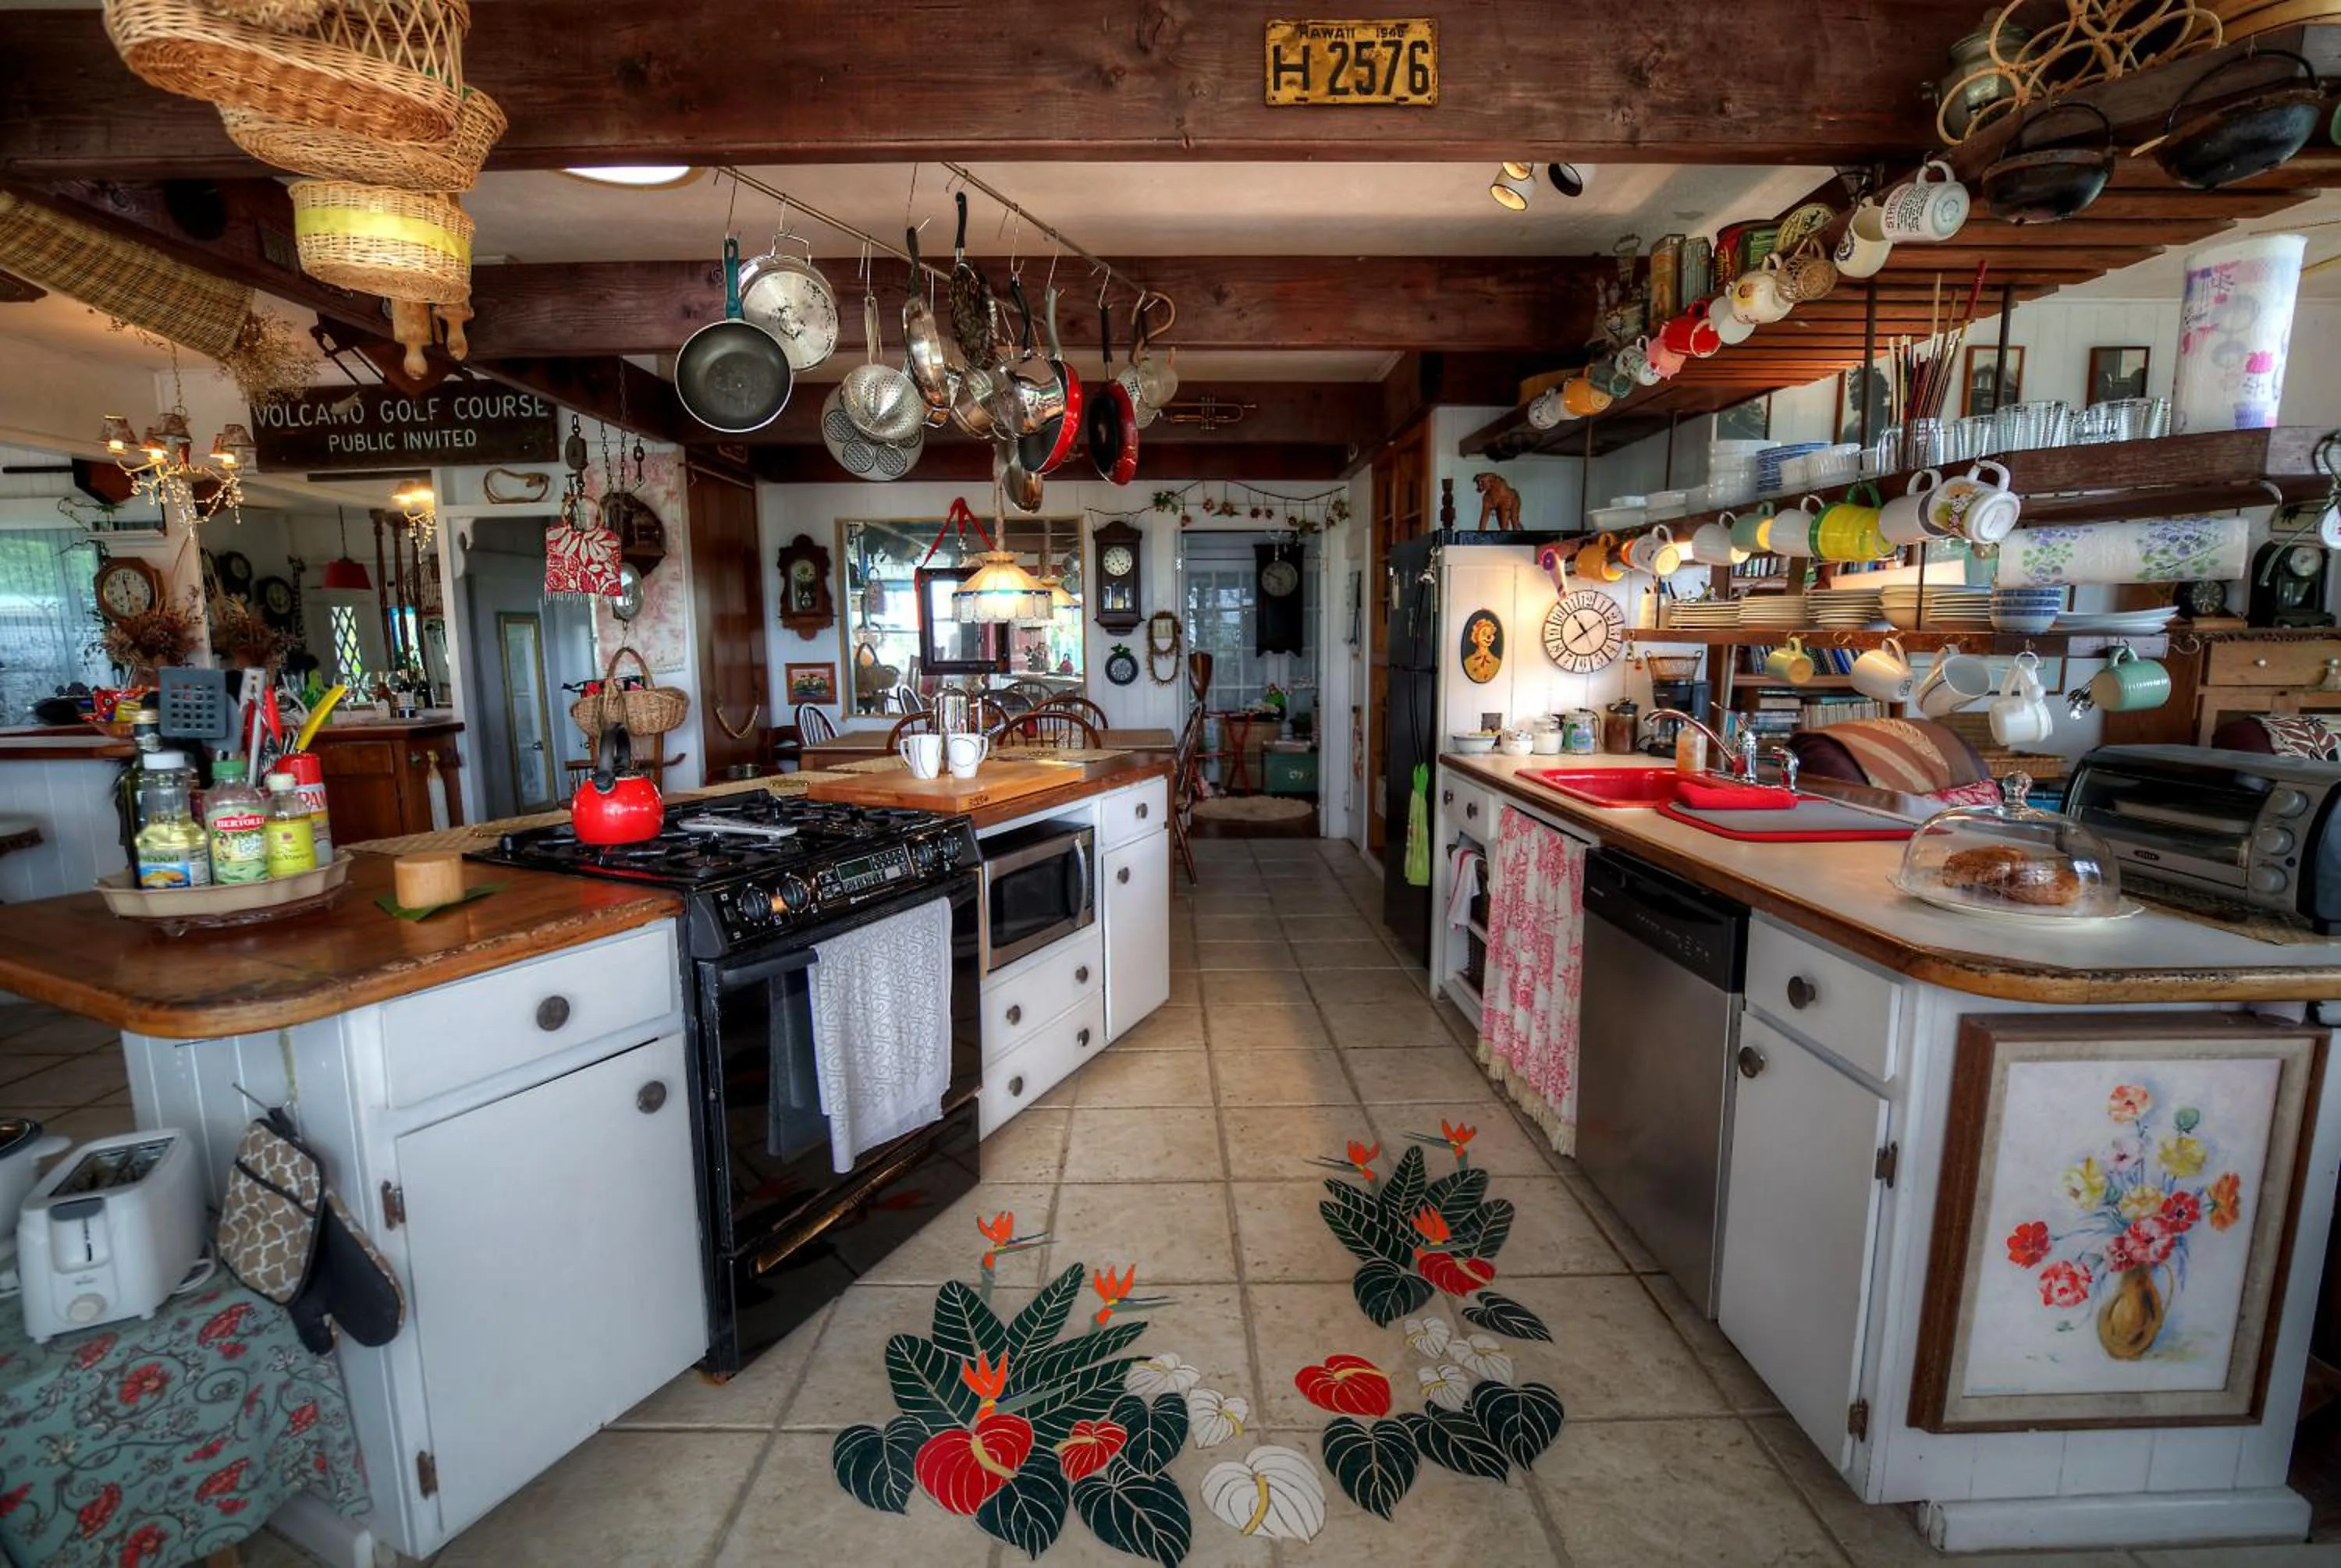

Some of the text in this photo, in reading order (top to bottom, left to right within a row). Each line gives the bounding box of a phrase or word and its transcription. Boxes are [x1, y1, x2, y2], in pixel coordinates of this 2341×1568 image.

[1298, 27, 1355, 39] HAWAII
[1273, 40, 1430, 96] H 2576
[379, 397, 442, 424] GOLF
[453, 394, 549, 420] COURSE
[328, 428, 478, 453] PUBLIC INVITED
